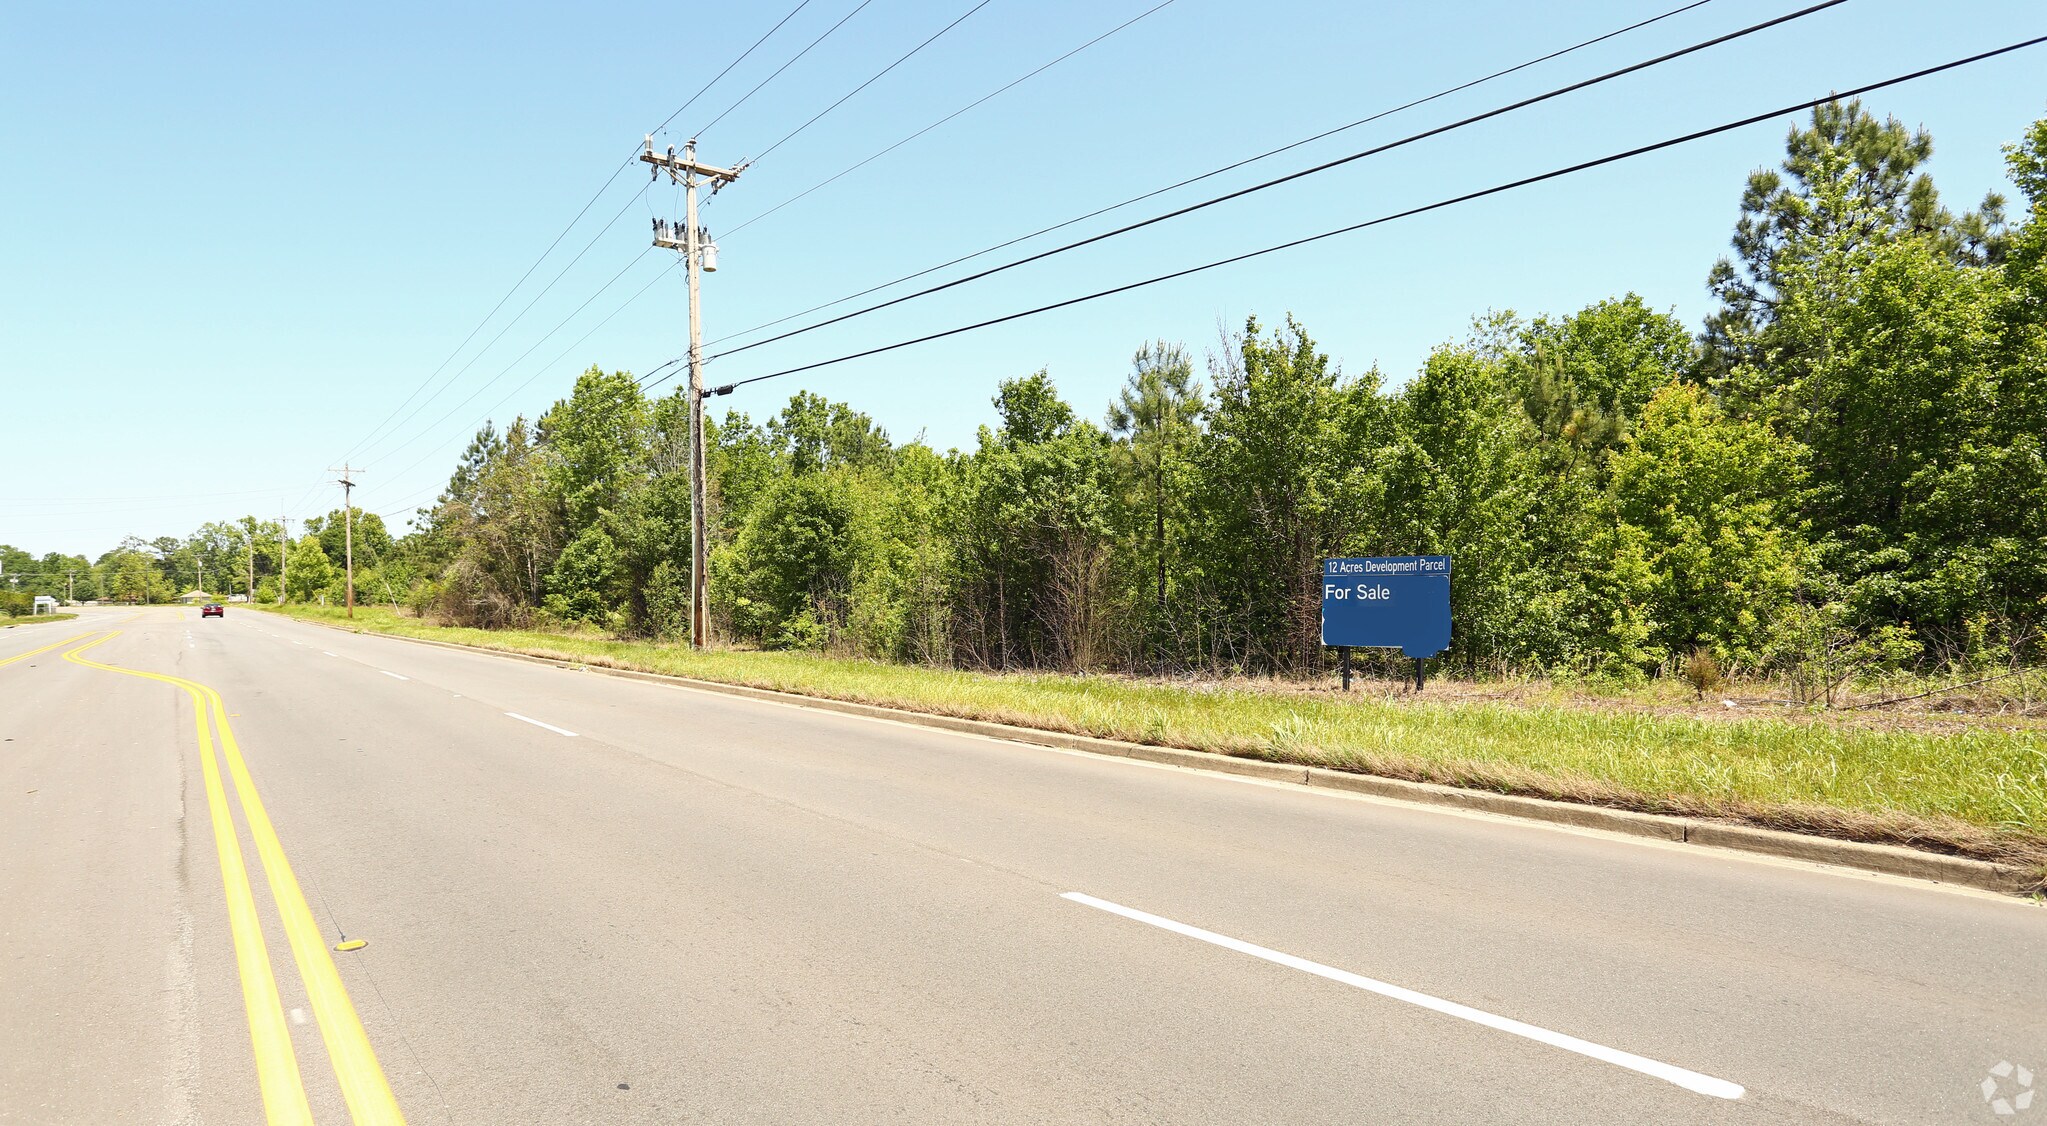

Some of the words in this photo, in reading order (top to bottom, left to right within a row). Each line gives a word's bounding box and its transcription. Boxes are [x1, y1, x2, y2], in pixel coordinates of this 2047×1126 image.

[1328, 561, 1338, 573] 12
[1339, 561, 1364, 573] Acres
[1365, 560, 1417, 575] Development
[1419, 558, 1446, 571] Parcel
[1325, 584, 1352, 600] For
[1356, 584, 1390, 600] Sale
